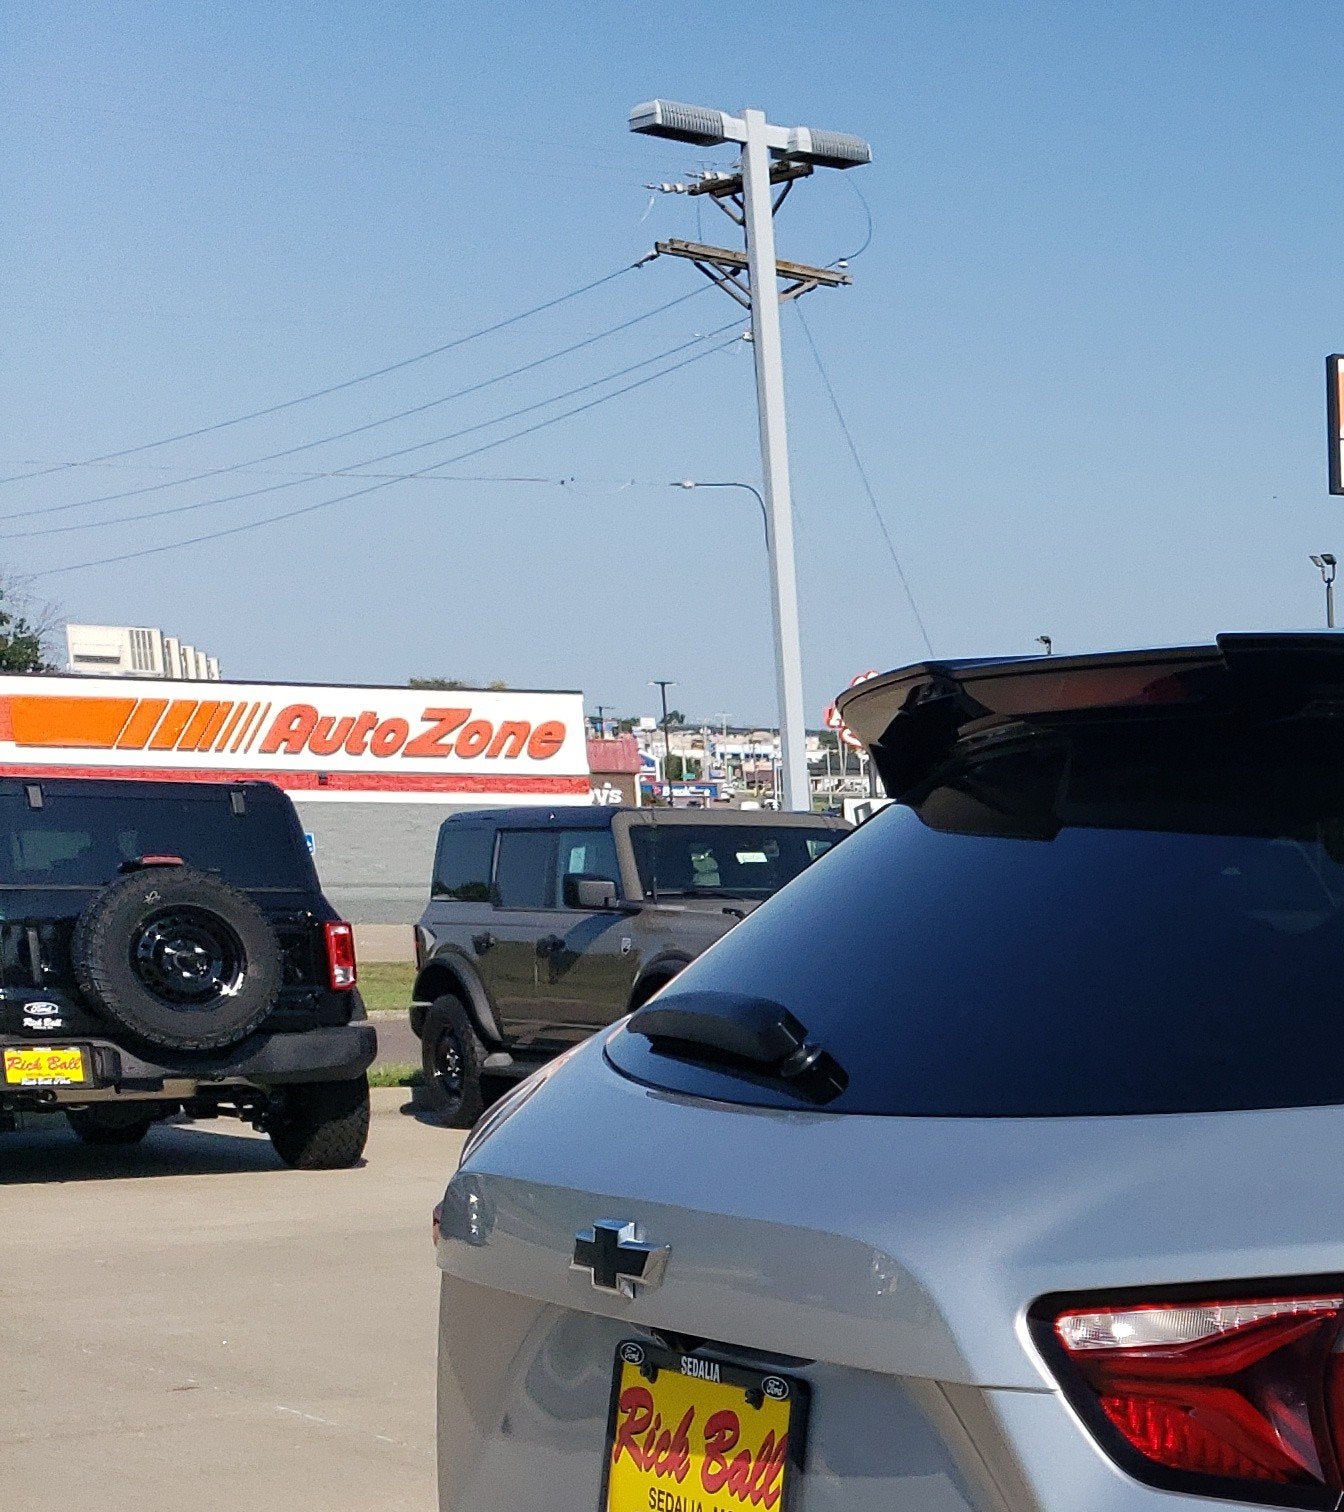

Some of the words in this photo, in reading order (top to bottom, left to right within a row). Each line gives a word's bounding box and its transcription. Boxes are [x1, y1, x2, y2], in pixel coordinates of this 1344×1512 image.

[258, 703, 567, 760] AutoZone
[7, 1056, 42, 1071] Rick
[47, 1055, 82, 1070] Ball
[680, 1355, 721, 1383] SEDALIA
[613, 1385, 695, 1484] Rick
[701, 1409, 789, 1510] Ball
